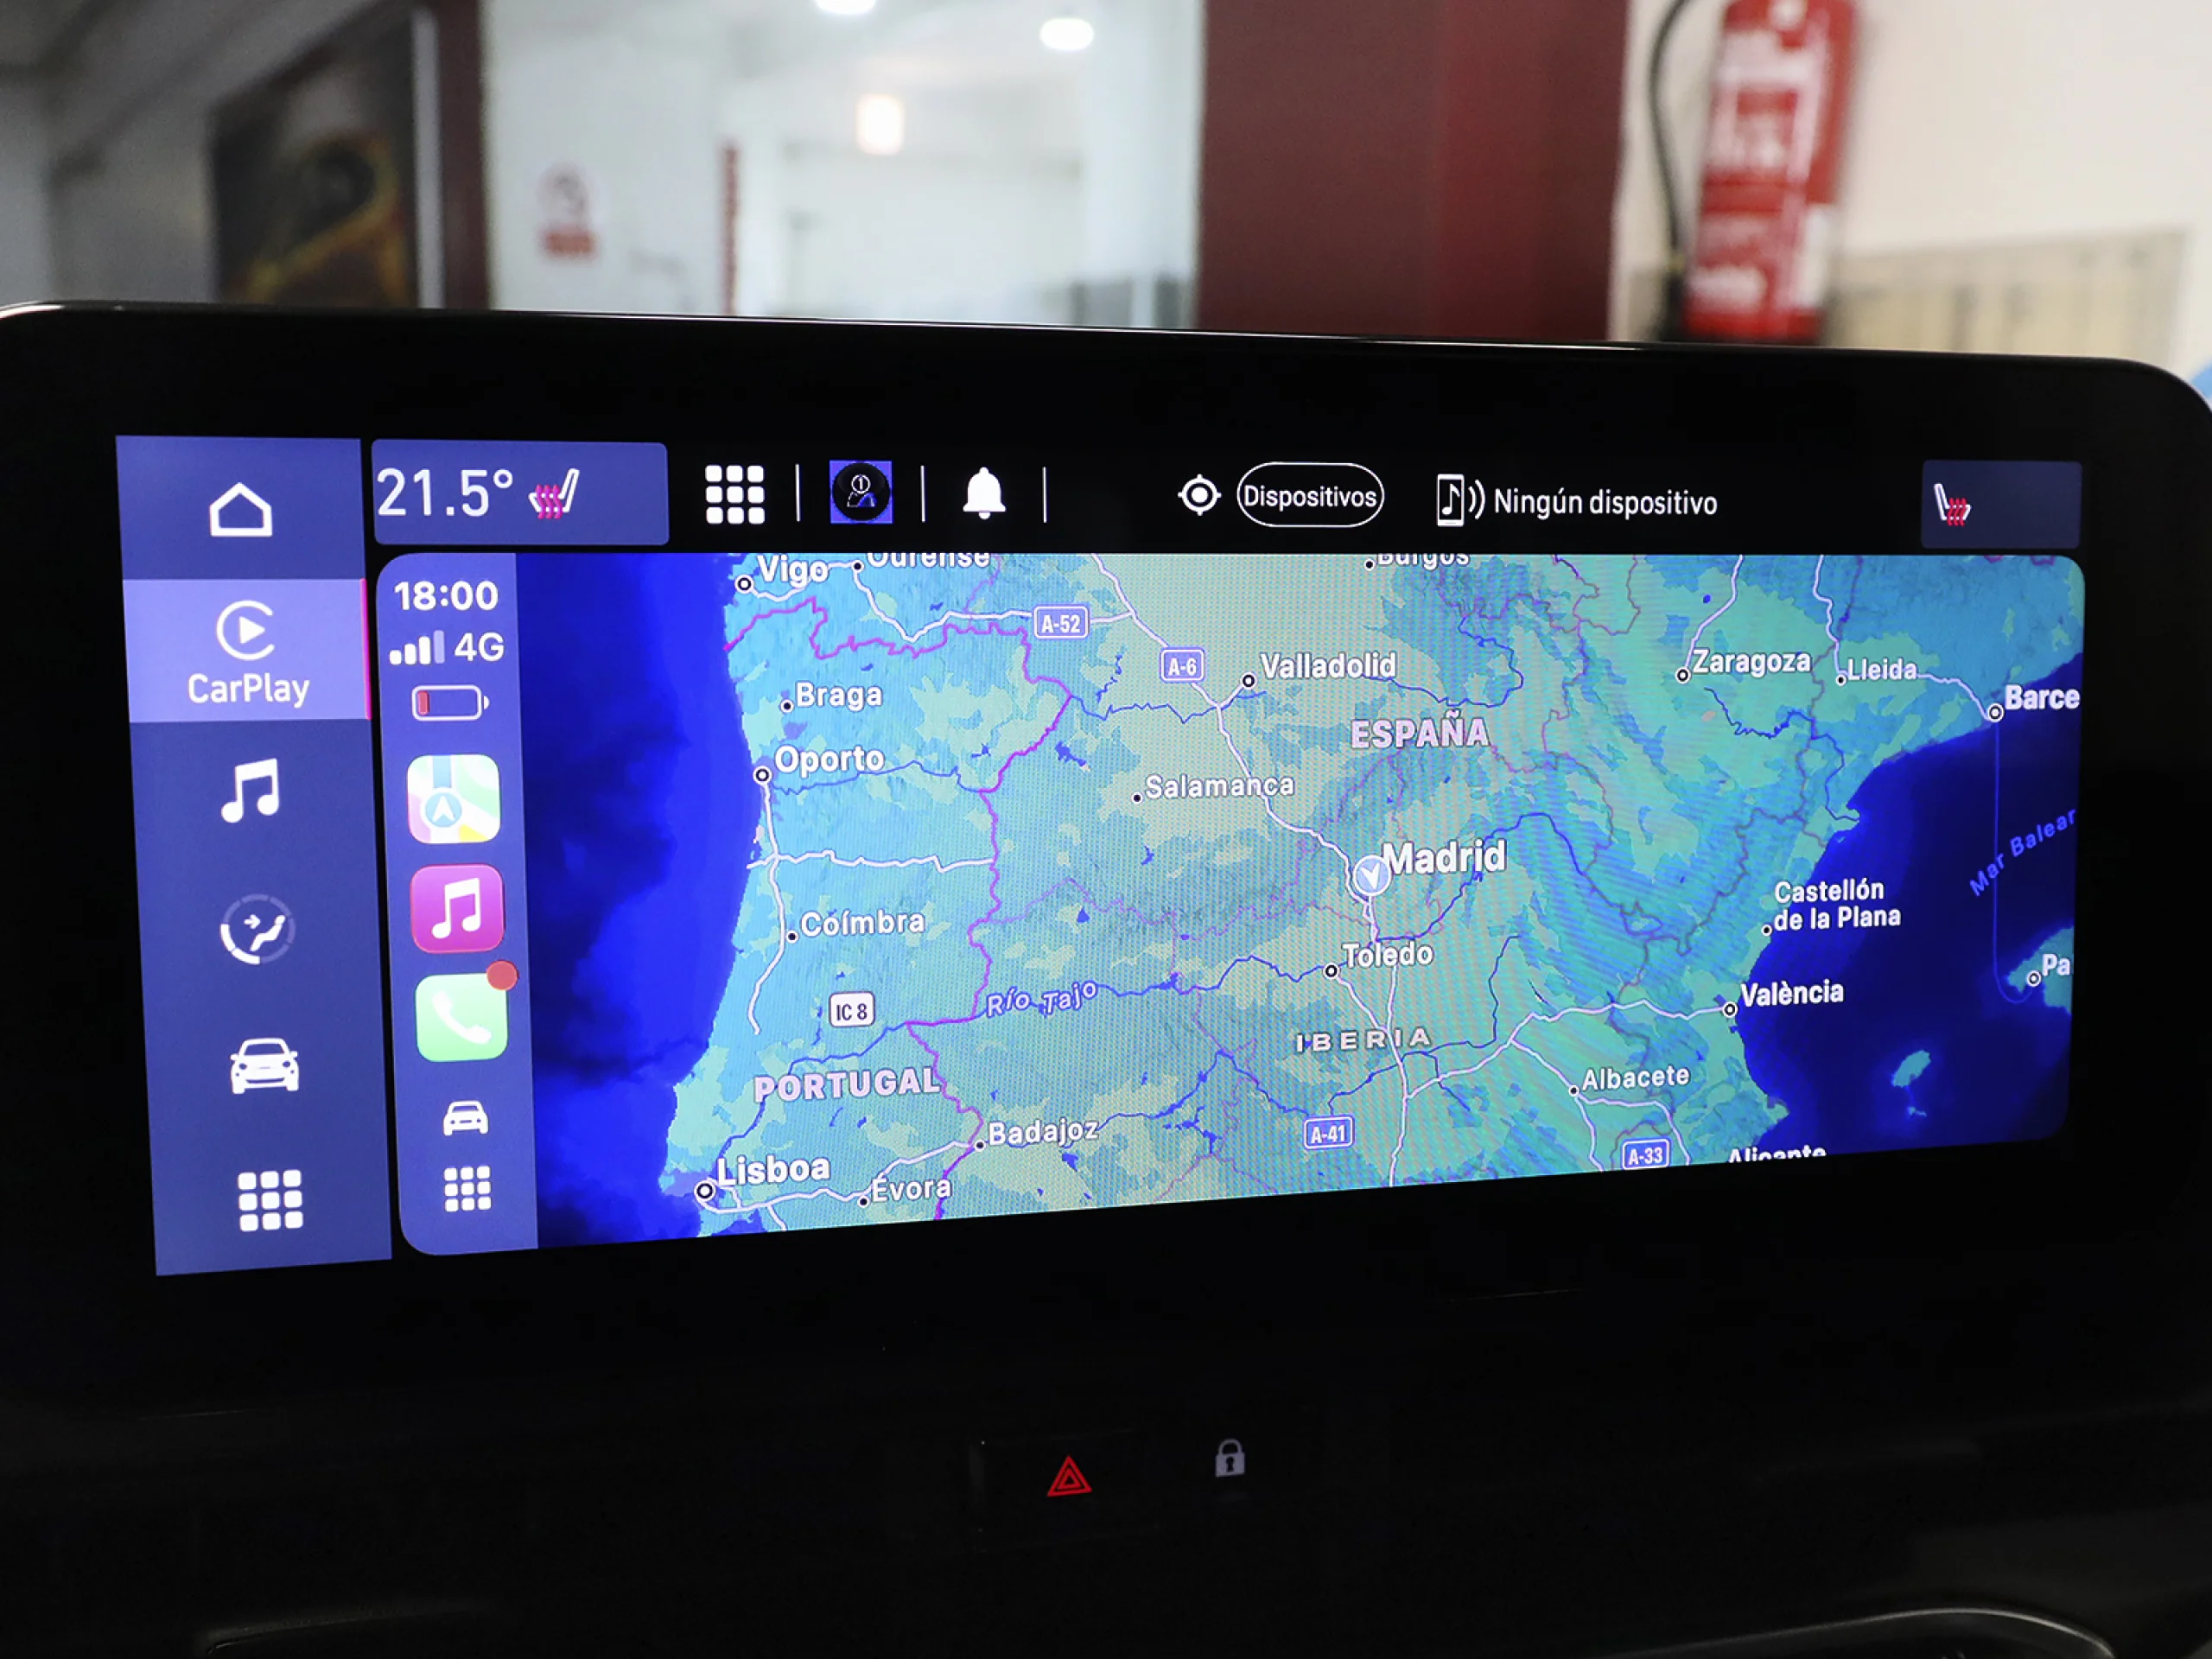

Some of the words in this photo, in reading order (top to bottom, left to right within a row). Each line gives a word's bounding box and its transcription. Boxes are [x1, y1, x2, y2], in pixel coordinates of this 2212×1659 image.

[377, 467, 514, 518] 21.5°
[1243, 485, 1377, 511] Dispositivos
[1494, 489, 1581, 520] Ningún
[1589, 491, 1718, 520] dispositivo
[757, 554, 830, 589] Vigo
[394, 581, 499, 610] 18:00
[1041, 614, 1081, 633] A-52
[454, 632, 505, 662] 4G
[1168, 657, 1198, 676] A-6
[1261, 653, 1397, 680] Valladolid
[1693, 650, 1811, 678] Zaragoza
[1847, 659, 1918, 682] Lleida
[188, 673, 309, 708] CarPlay
[796, 683, 883, 710] Braga
[2005, 684, 2081, 710] Barce
[1351, 710, 1490, 750] ESPAÑA
[775, 746, 886, 779] Oporto
[1145, 773, 1296, 800] Salamanca
[1383, 839, 1508, 874] Madrid
[1969, 853, 2005, 897] Mar
[2010, 808, 2076, 857] Balear
[1774, 878, 1885, 904] Castellón
[800, 908, 926, 938] Coímbra
[1774, 910, 1802, 931] de
[1811, 907, 1830, 929] la
[1838, 906, 1901, 929] Plana
[1344, 943, 1434, 968] Toledo
[2041, 952, 2071, 977] Pa
[987, 986, 1032, 1018] Río
[1042, 981, 1098, 1015] Tajo
[1740, 981, 1844, 1008] València
[836, 1005, 851, 1020] IC
[856, 1003, 868, 1020] 8
[1296, 1027, 1431, 1052] IBERIA
[754, 1067, 943, 1103] PORTUGAL
[1582, 1065, 1691, 1092] Albacete
[988, 1118, 1100, 1147] Badajoz
[1311, 1123, 1346, 1144] A-41
[1628, 1146, 1663, 1164] A-33
[717, 1155, 831, 1187] Lisboa
[873, 1176, 952, 1204] Évora
